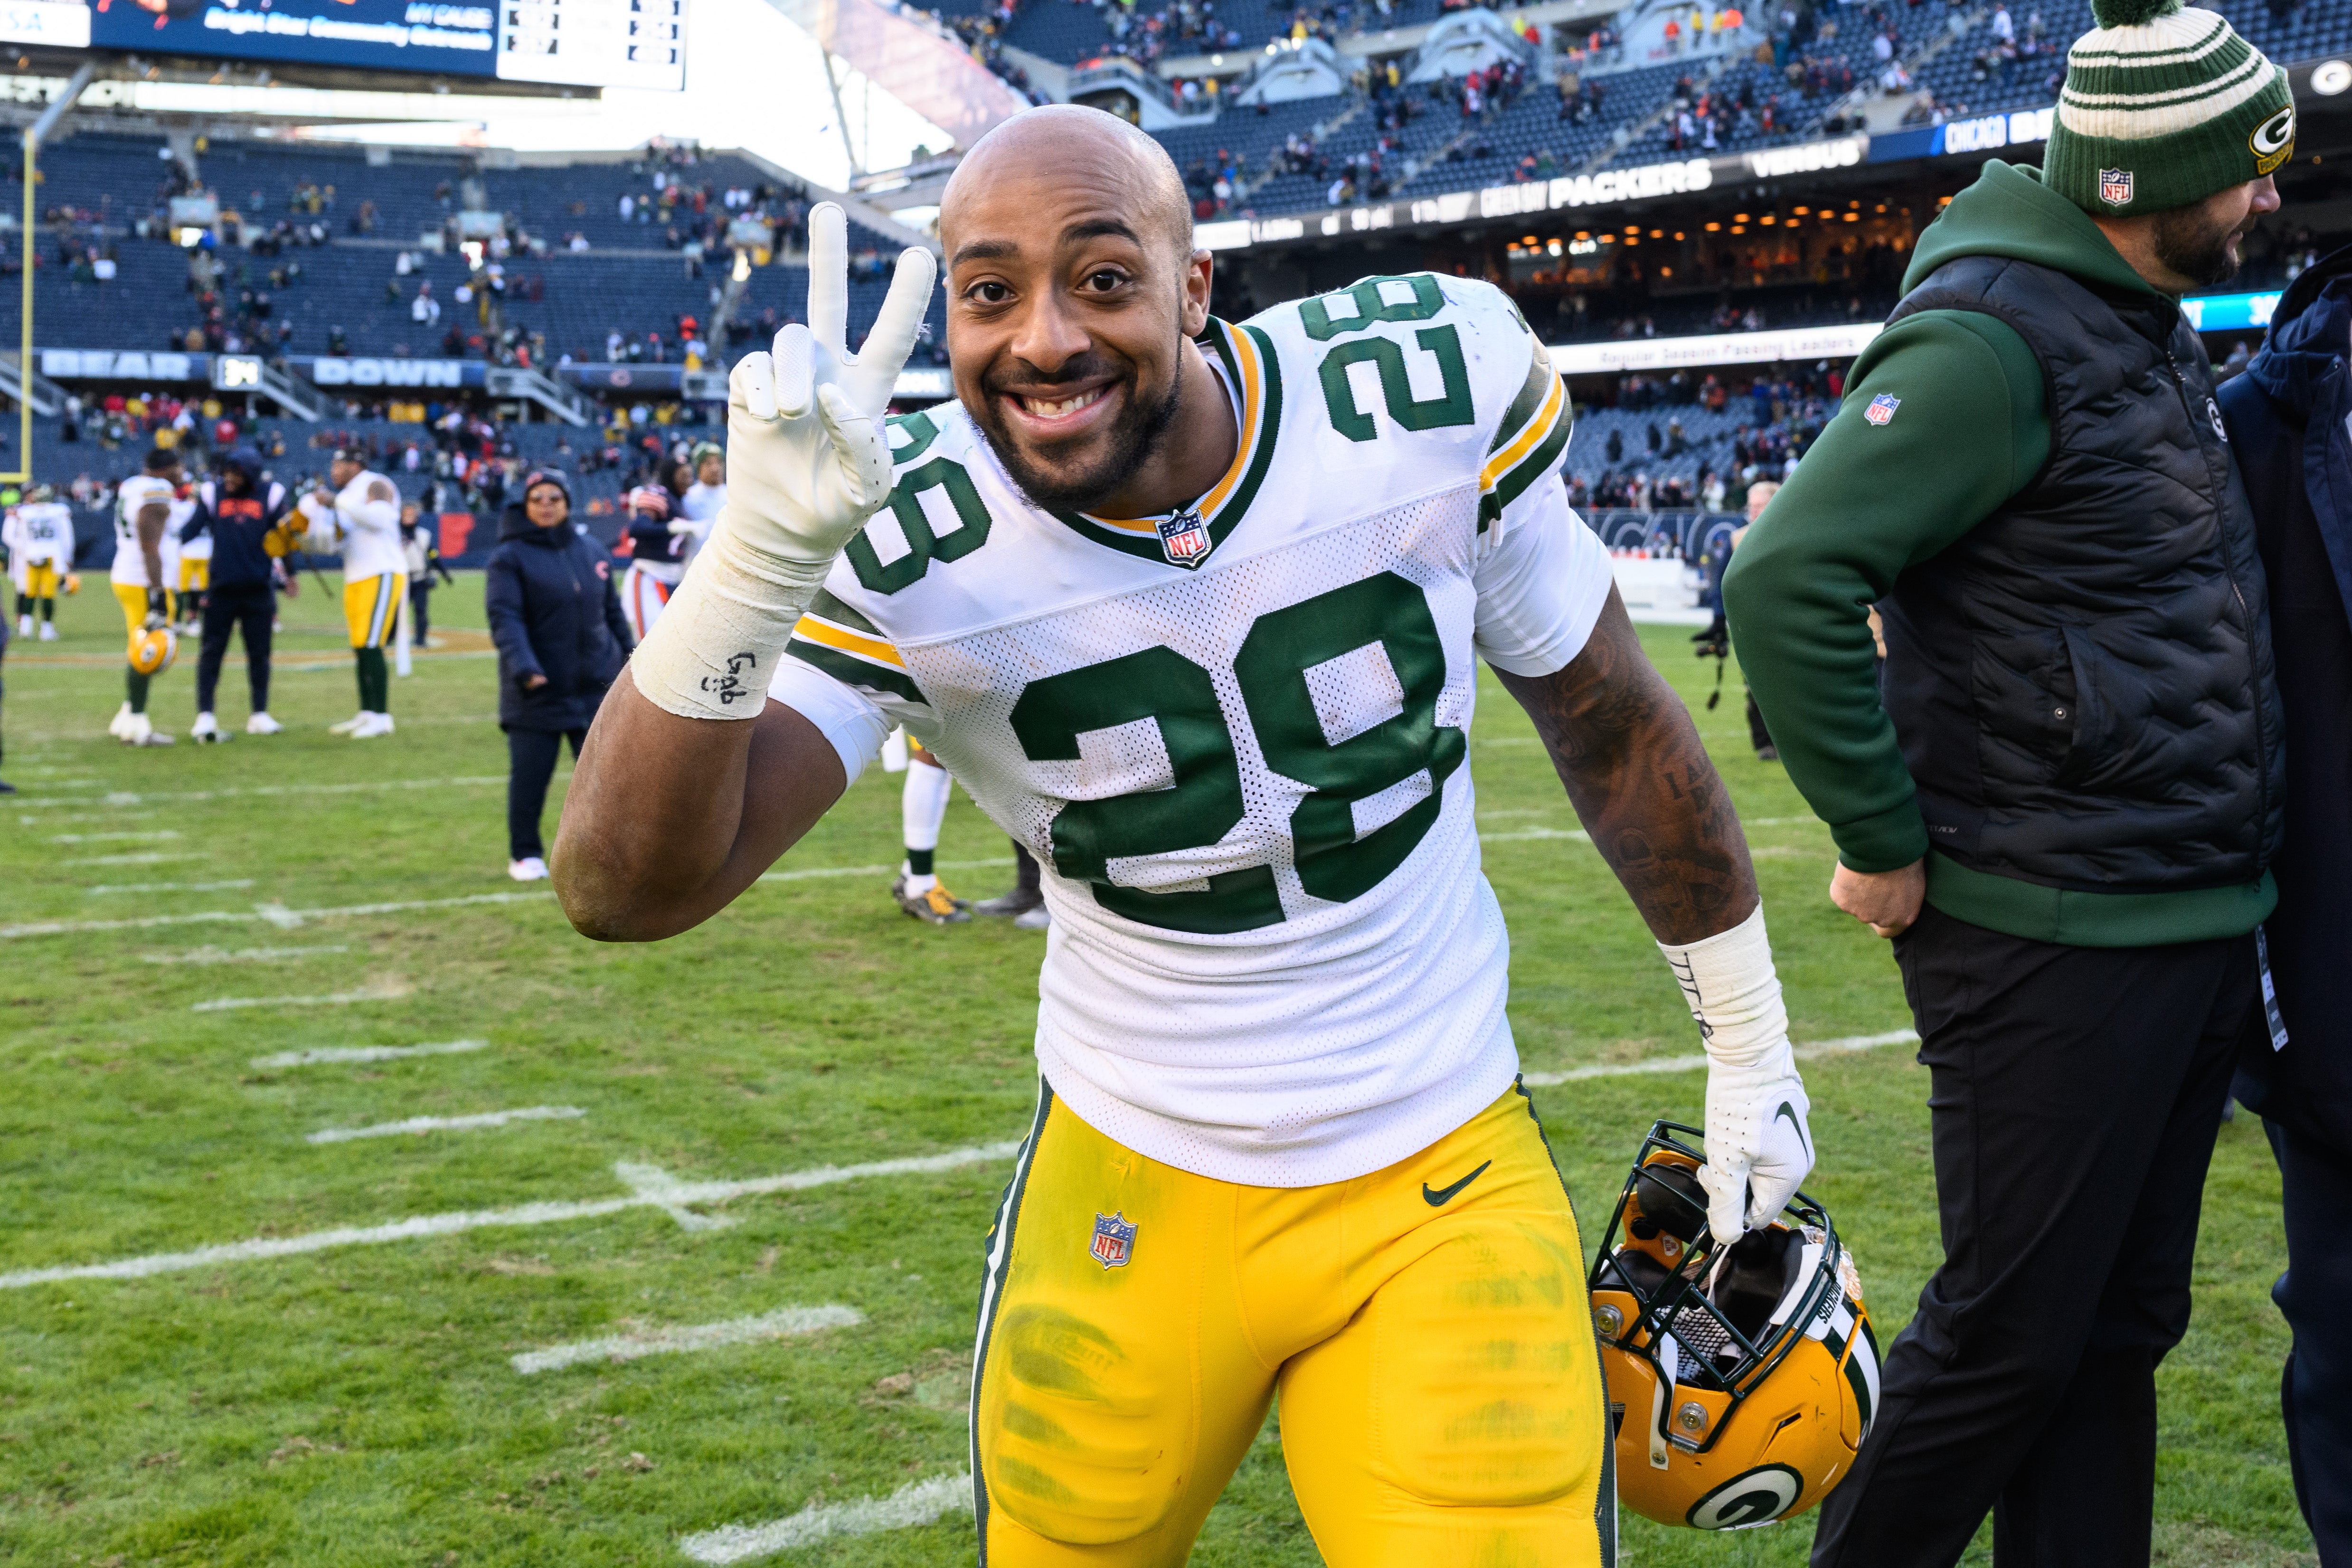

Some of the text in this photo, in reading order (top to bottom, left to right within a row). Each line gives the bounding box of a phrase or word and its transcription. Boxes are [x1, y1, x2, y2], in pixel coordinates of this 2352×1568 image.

[1750, 139, 1860, 178] VERSUS
[1550, 158, 1713, 209] PACKERS
[2104, 184, 2128, 201] NFL
[314, 356, 462, 387] DOWN
[1297, 270, 1475, 443] 28
[1868, 404, 1889, 421] NFL
[1168, 531, 1204, 556] NFL
[1010, 570, 1466, 934] 28
[1095, 1235, 1124, 1260] NFL
